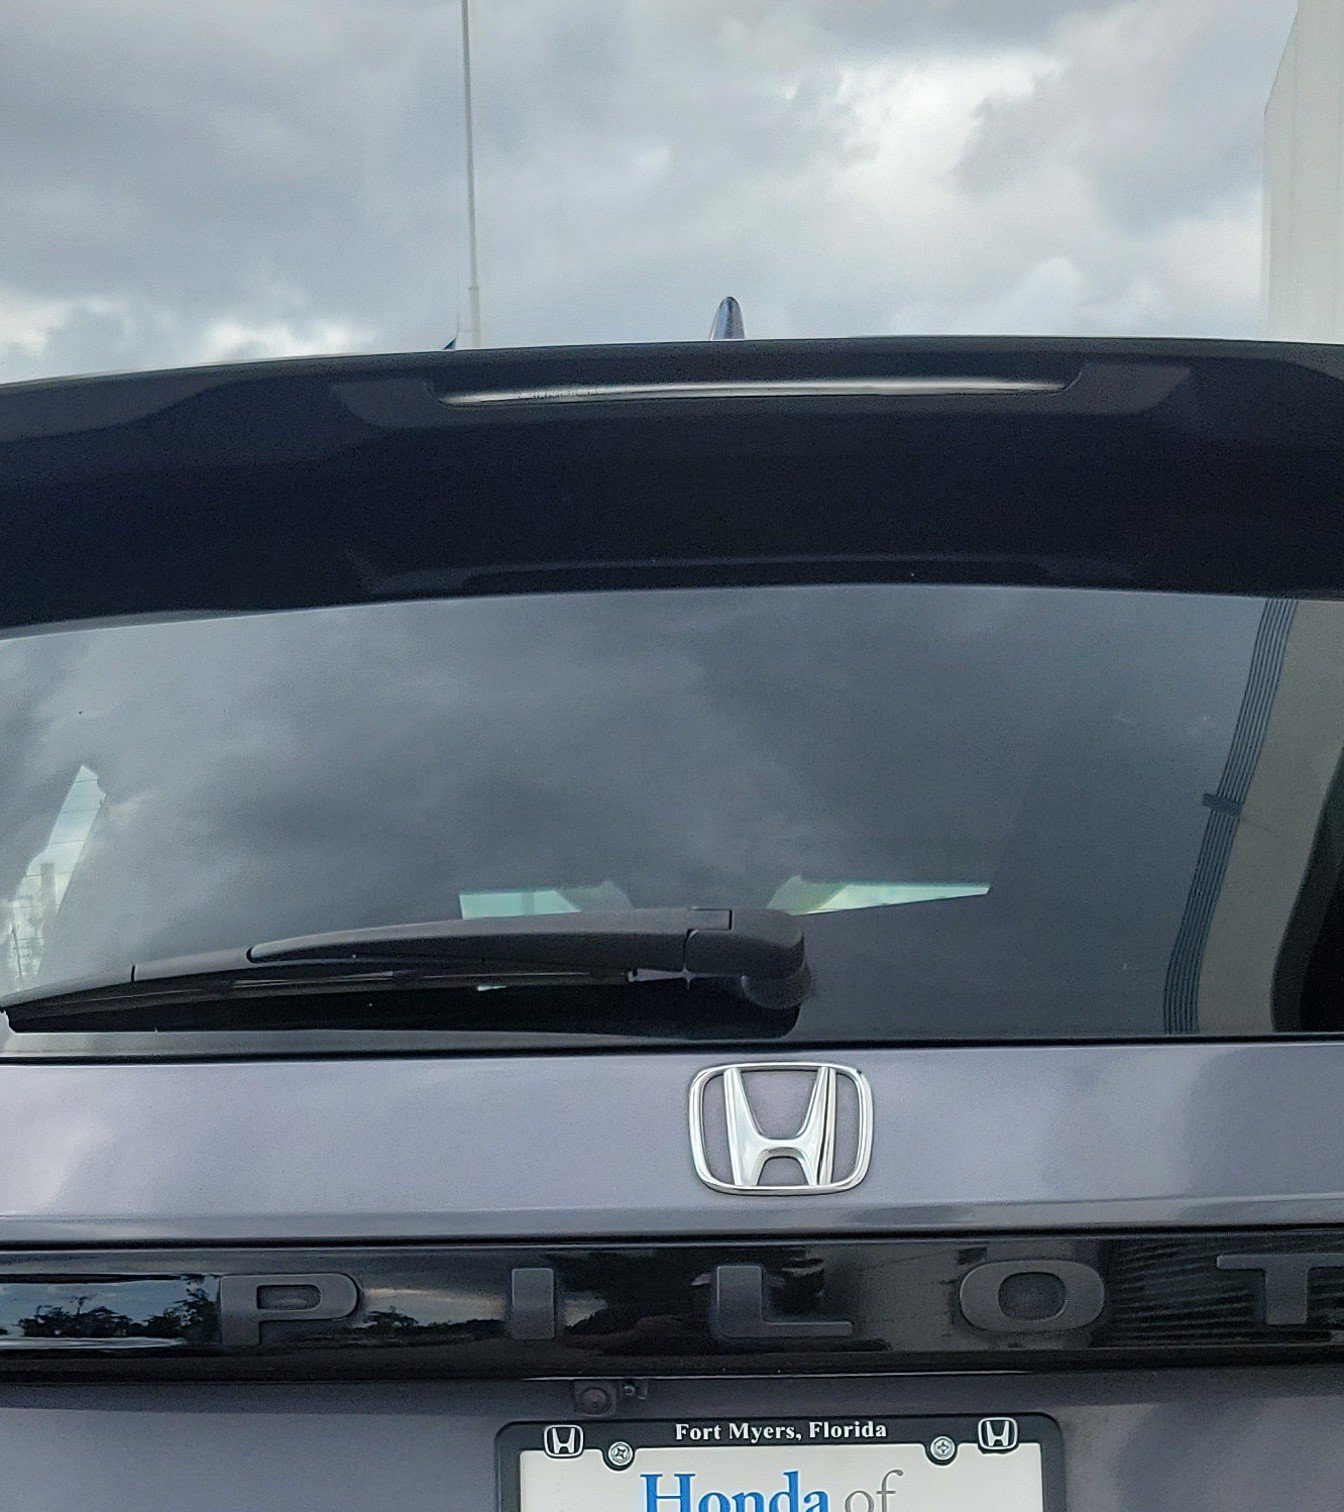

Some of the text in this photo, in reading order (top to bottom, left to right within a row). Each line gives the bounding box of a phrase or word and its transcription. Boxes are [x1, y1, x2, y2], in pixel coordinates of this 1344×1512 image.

[675, 1420, 887, 1442] Fort Myers, Florida
